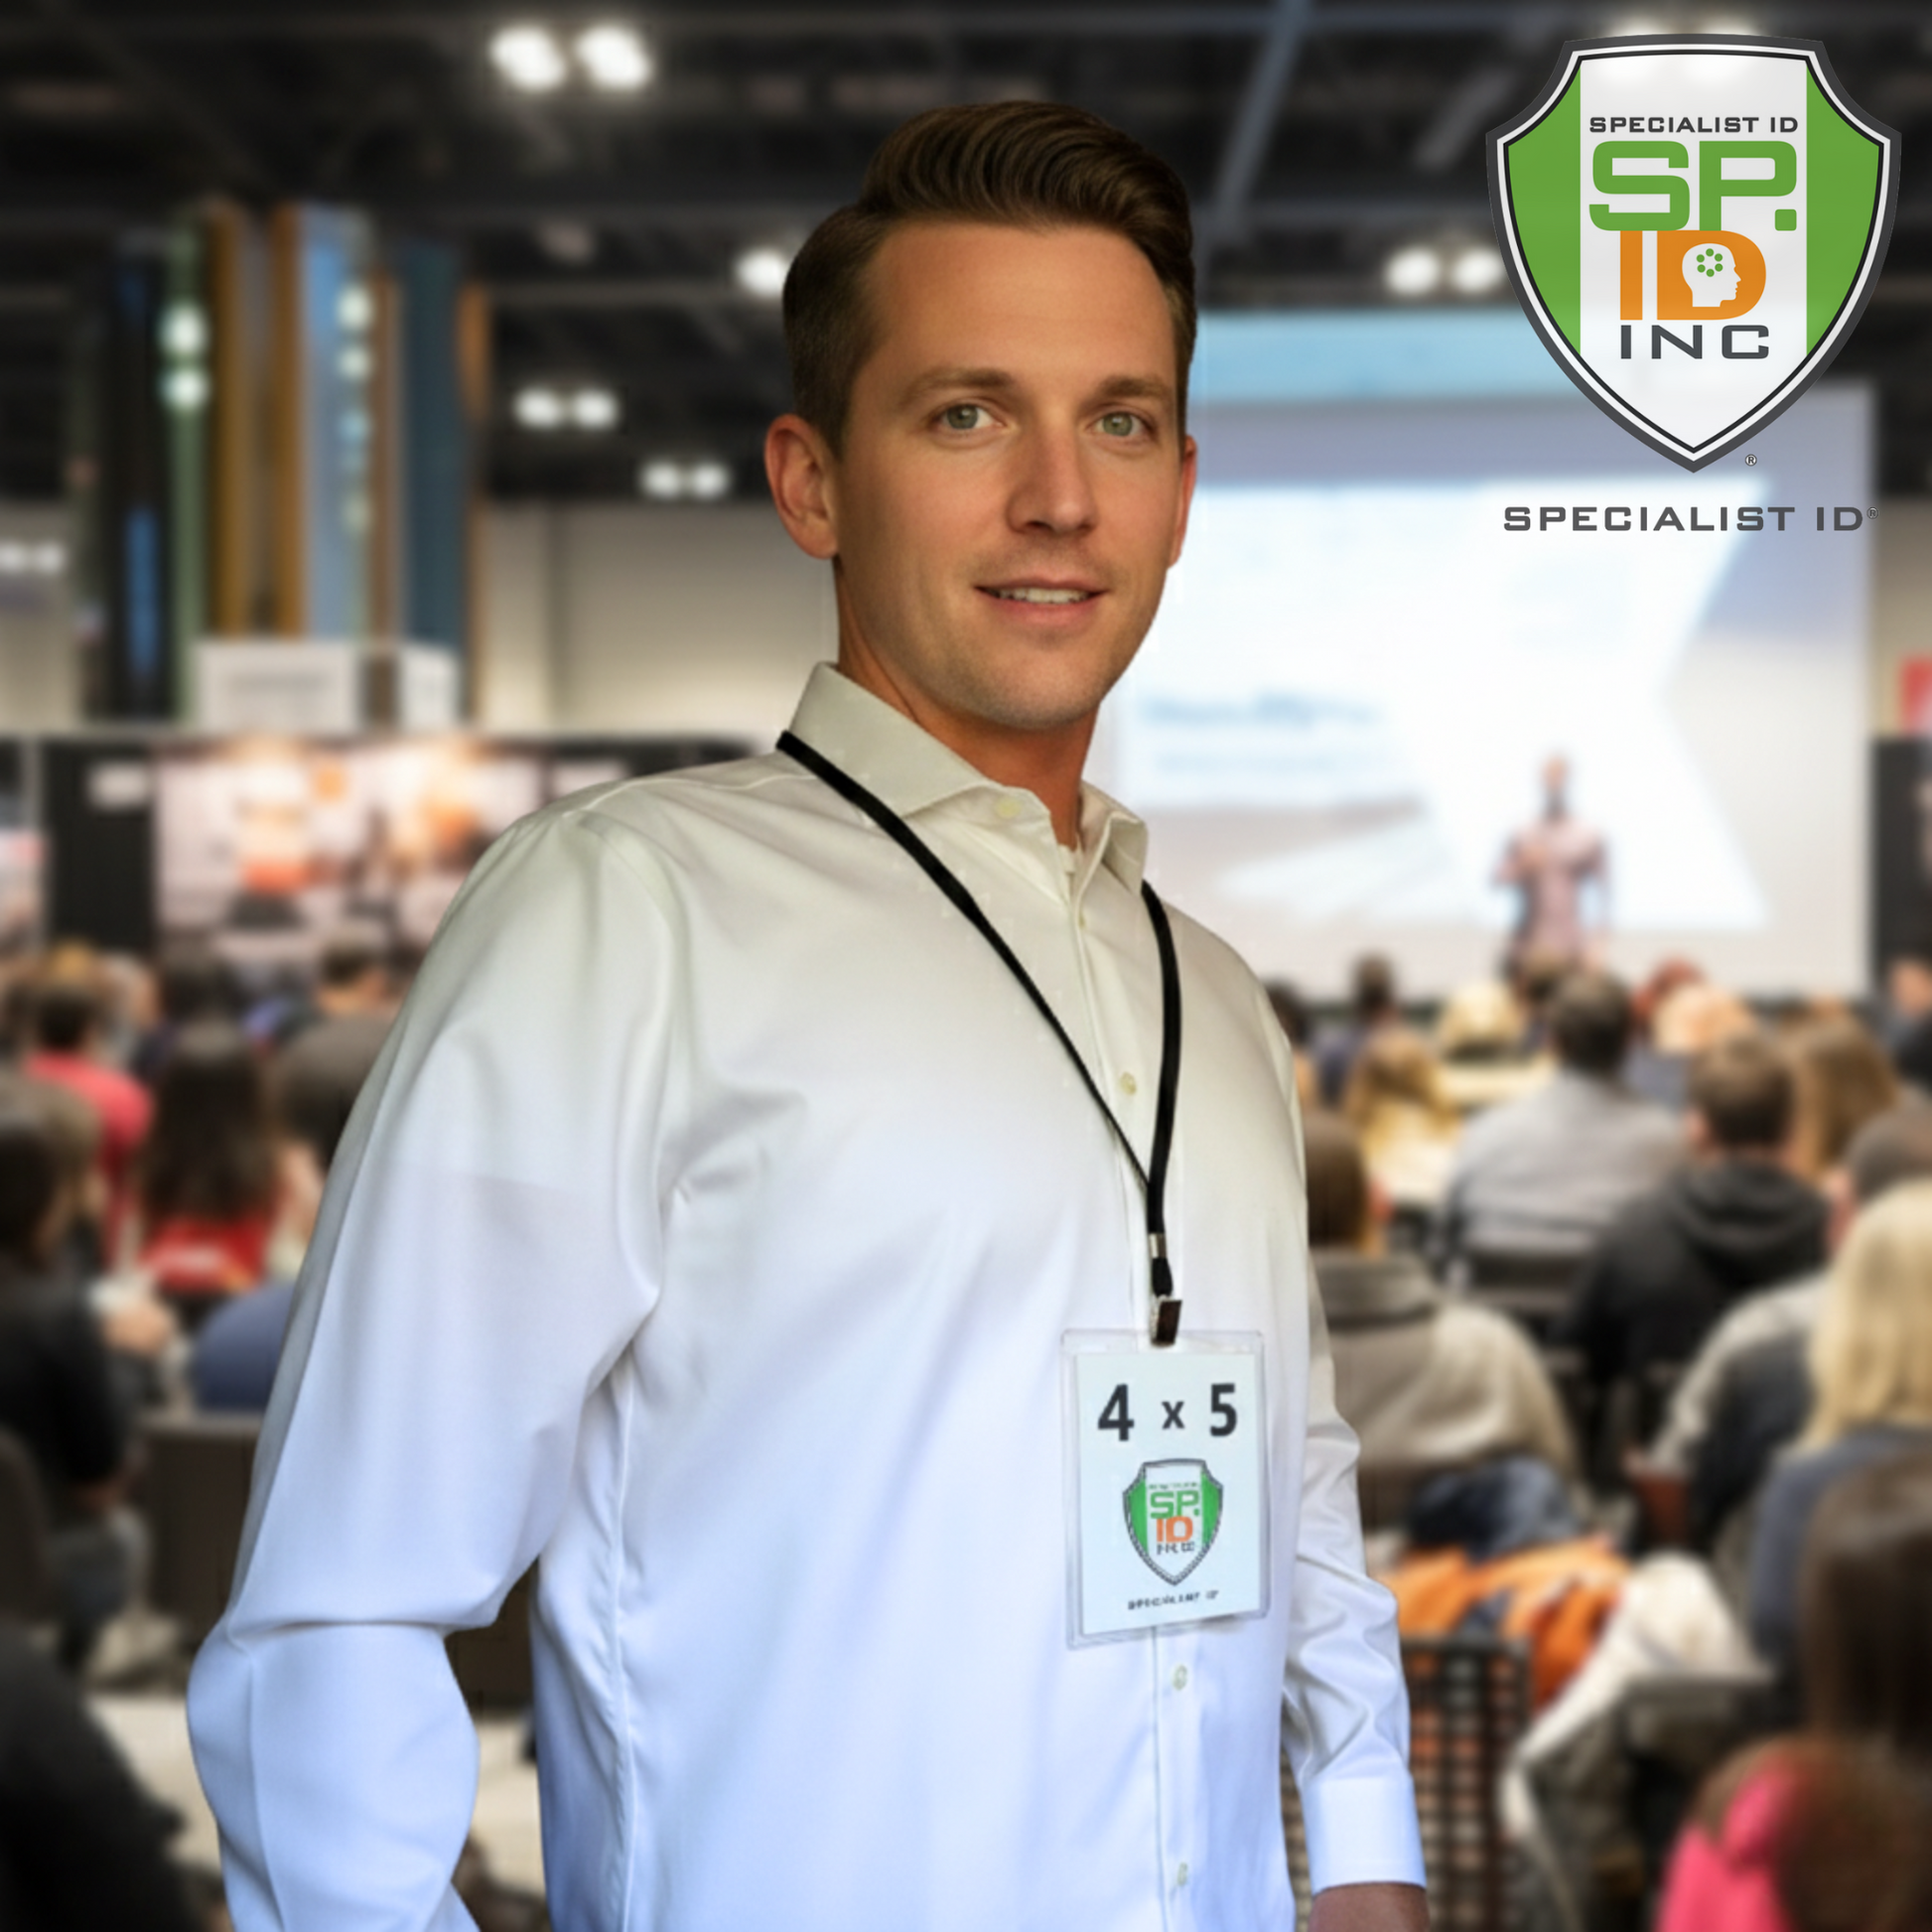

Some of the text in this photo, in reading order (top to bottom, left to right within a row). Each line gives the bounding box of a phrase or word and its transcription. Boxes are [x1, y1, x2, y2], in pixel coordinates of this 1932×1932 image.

[1097, 1383, 1237, 1442] 4 x 5
[1157, 1516, 1193, 1543] ID
